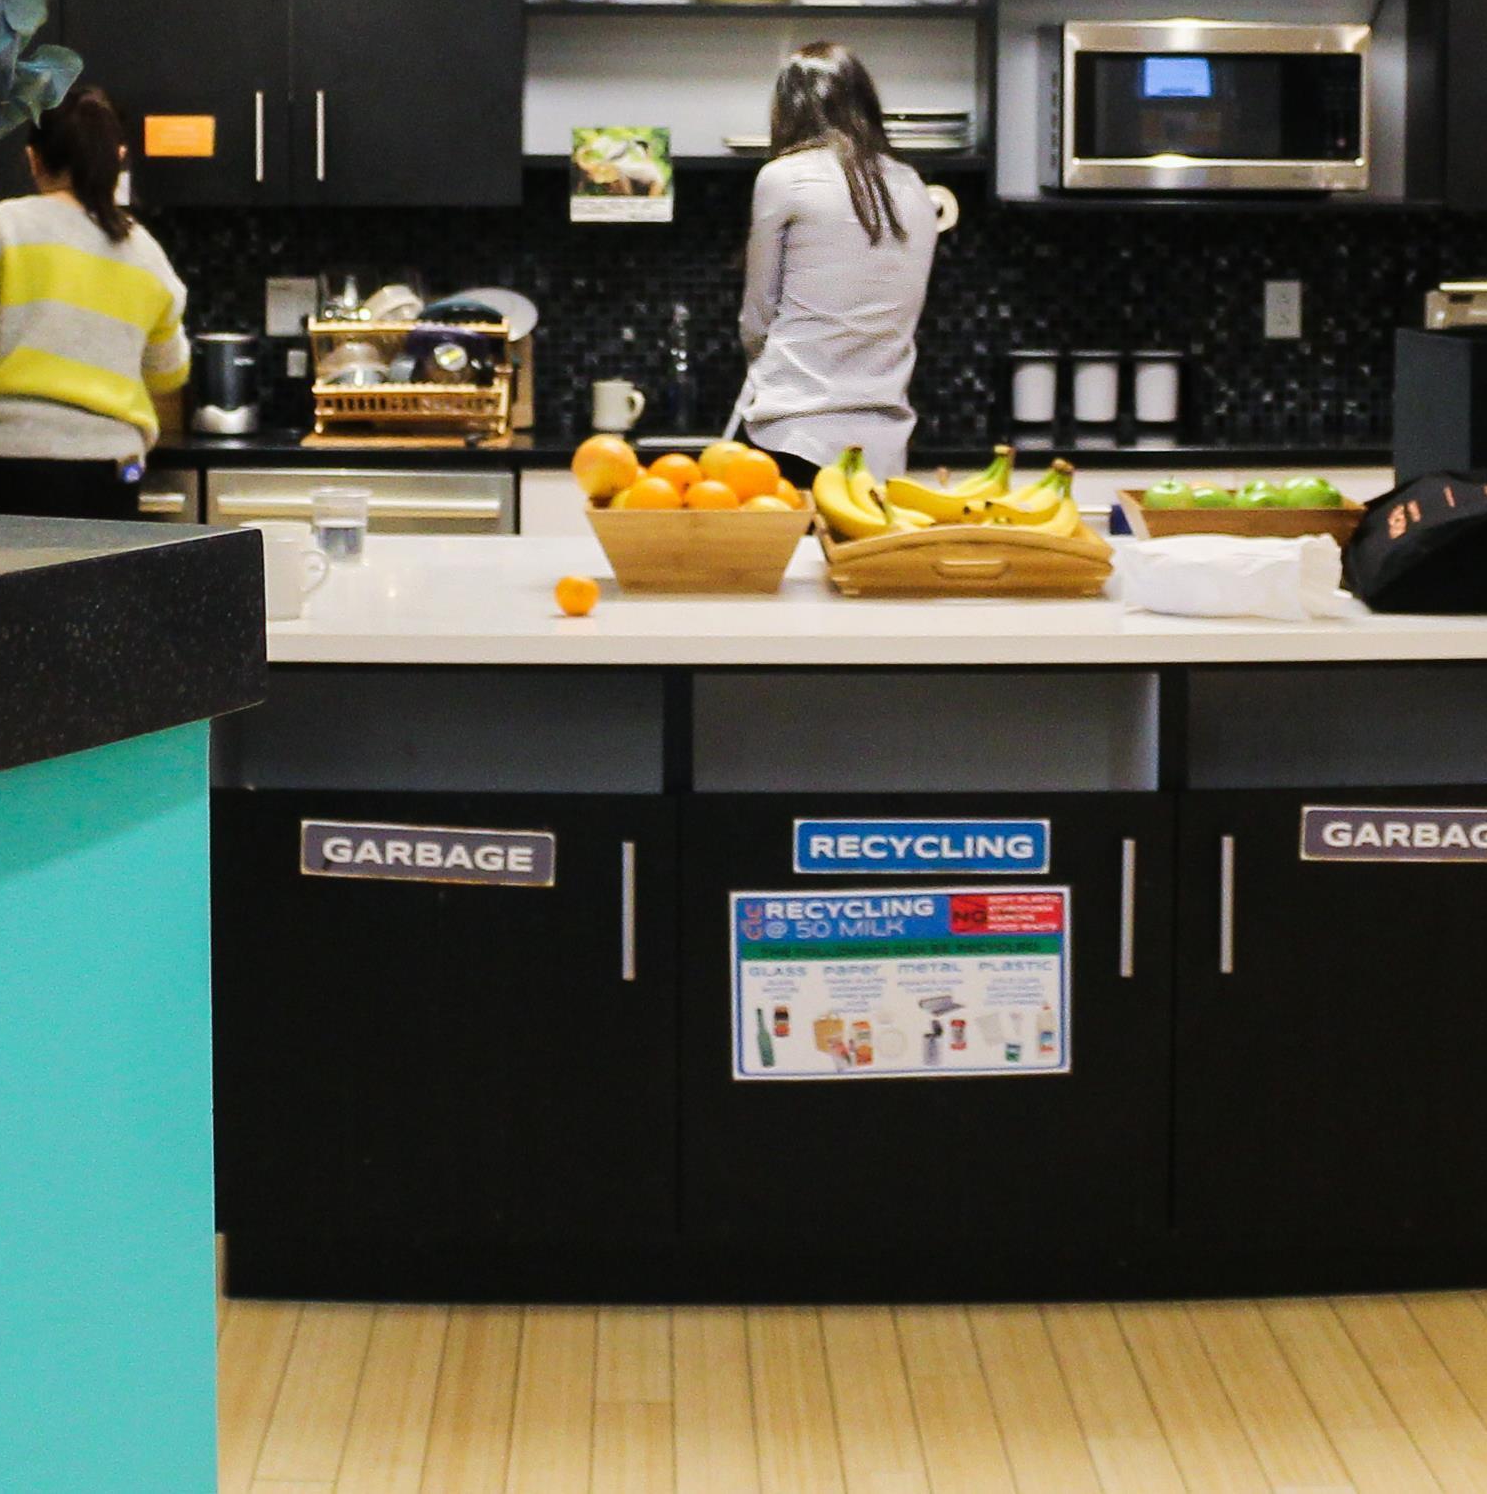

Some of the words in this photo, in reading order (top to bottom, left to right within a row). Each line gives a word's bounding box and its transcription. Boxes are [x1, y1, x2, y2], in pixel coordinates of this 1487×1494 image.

[321, 836, 535, 873] GARBAGE
[809, 834, 1034, 859] RECYCLING
[764, 898, 935, 920] RECYCLING
[764, 920, 788, 939] @
[795, 920, 832, 939] 50
[839, 918, 905, 937] MILK
